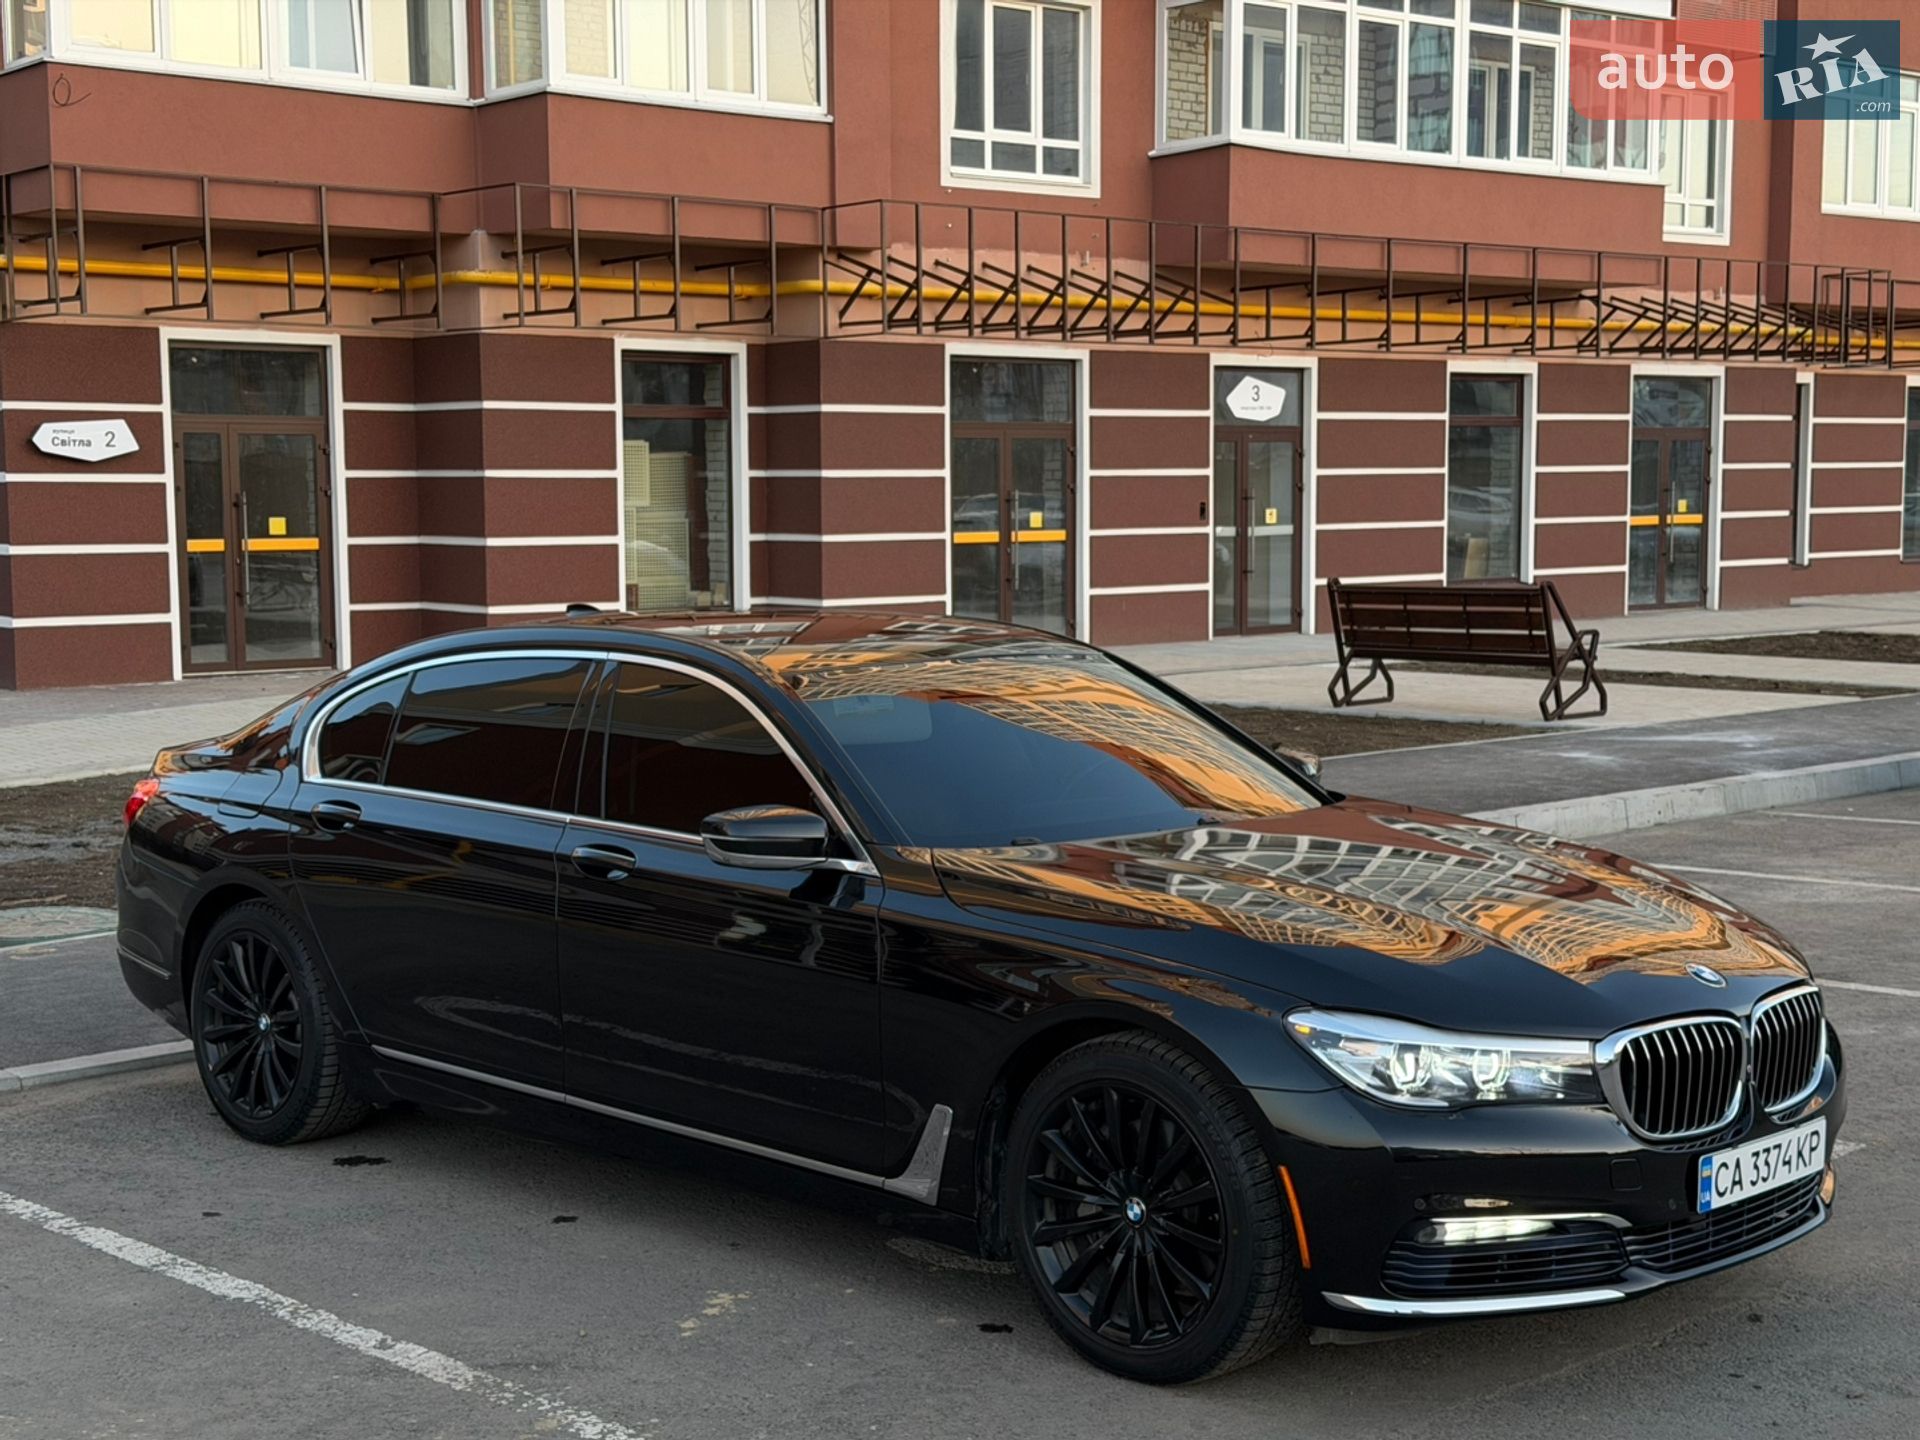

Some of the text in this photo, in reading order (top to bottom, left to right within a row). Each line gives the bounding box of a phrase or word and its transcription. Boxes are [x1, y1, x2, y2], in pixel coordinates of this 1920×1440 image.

[1252, 385, 1260, 402] 3
[52, 437, 92, 447] Світла
[105, 431, 116, 447] 2
[1750, 1139, 1792, 1186] 3374
